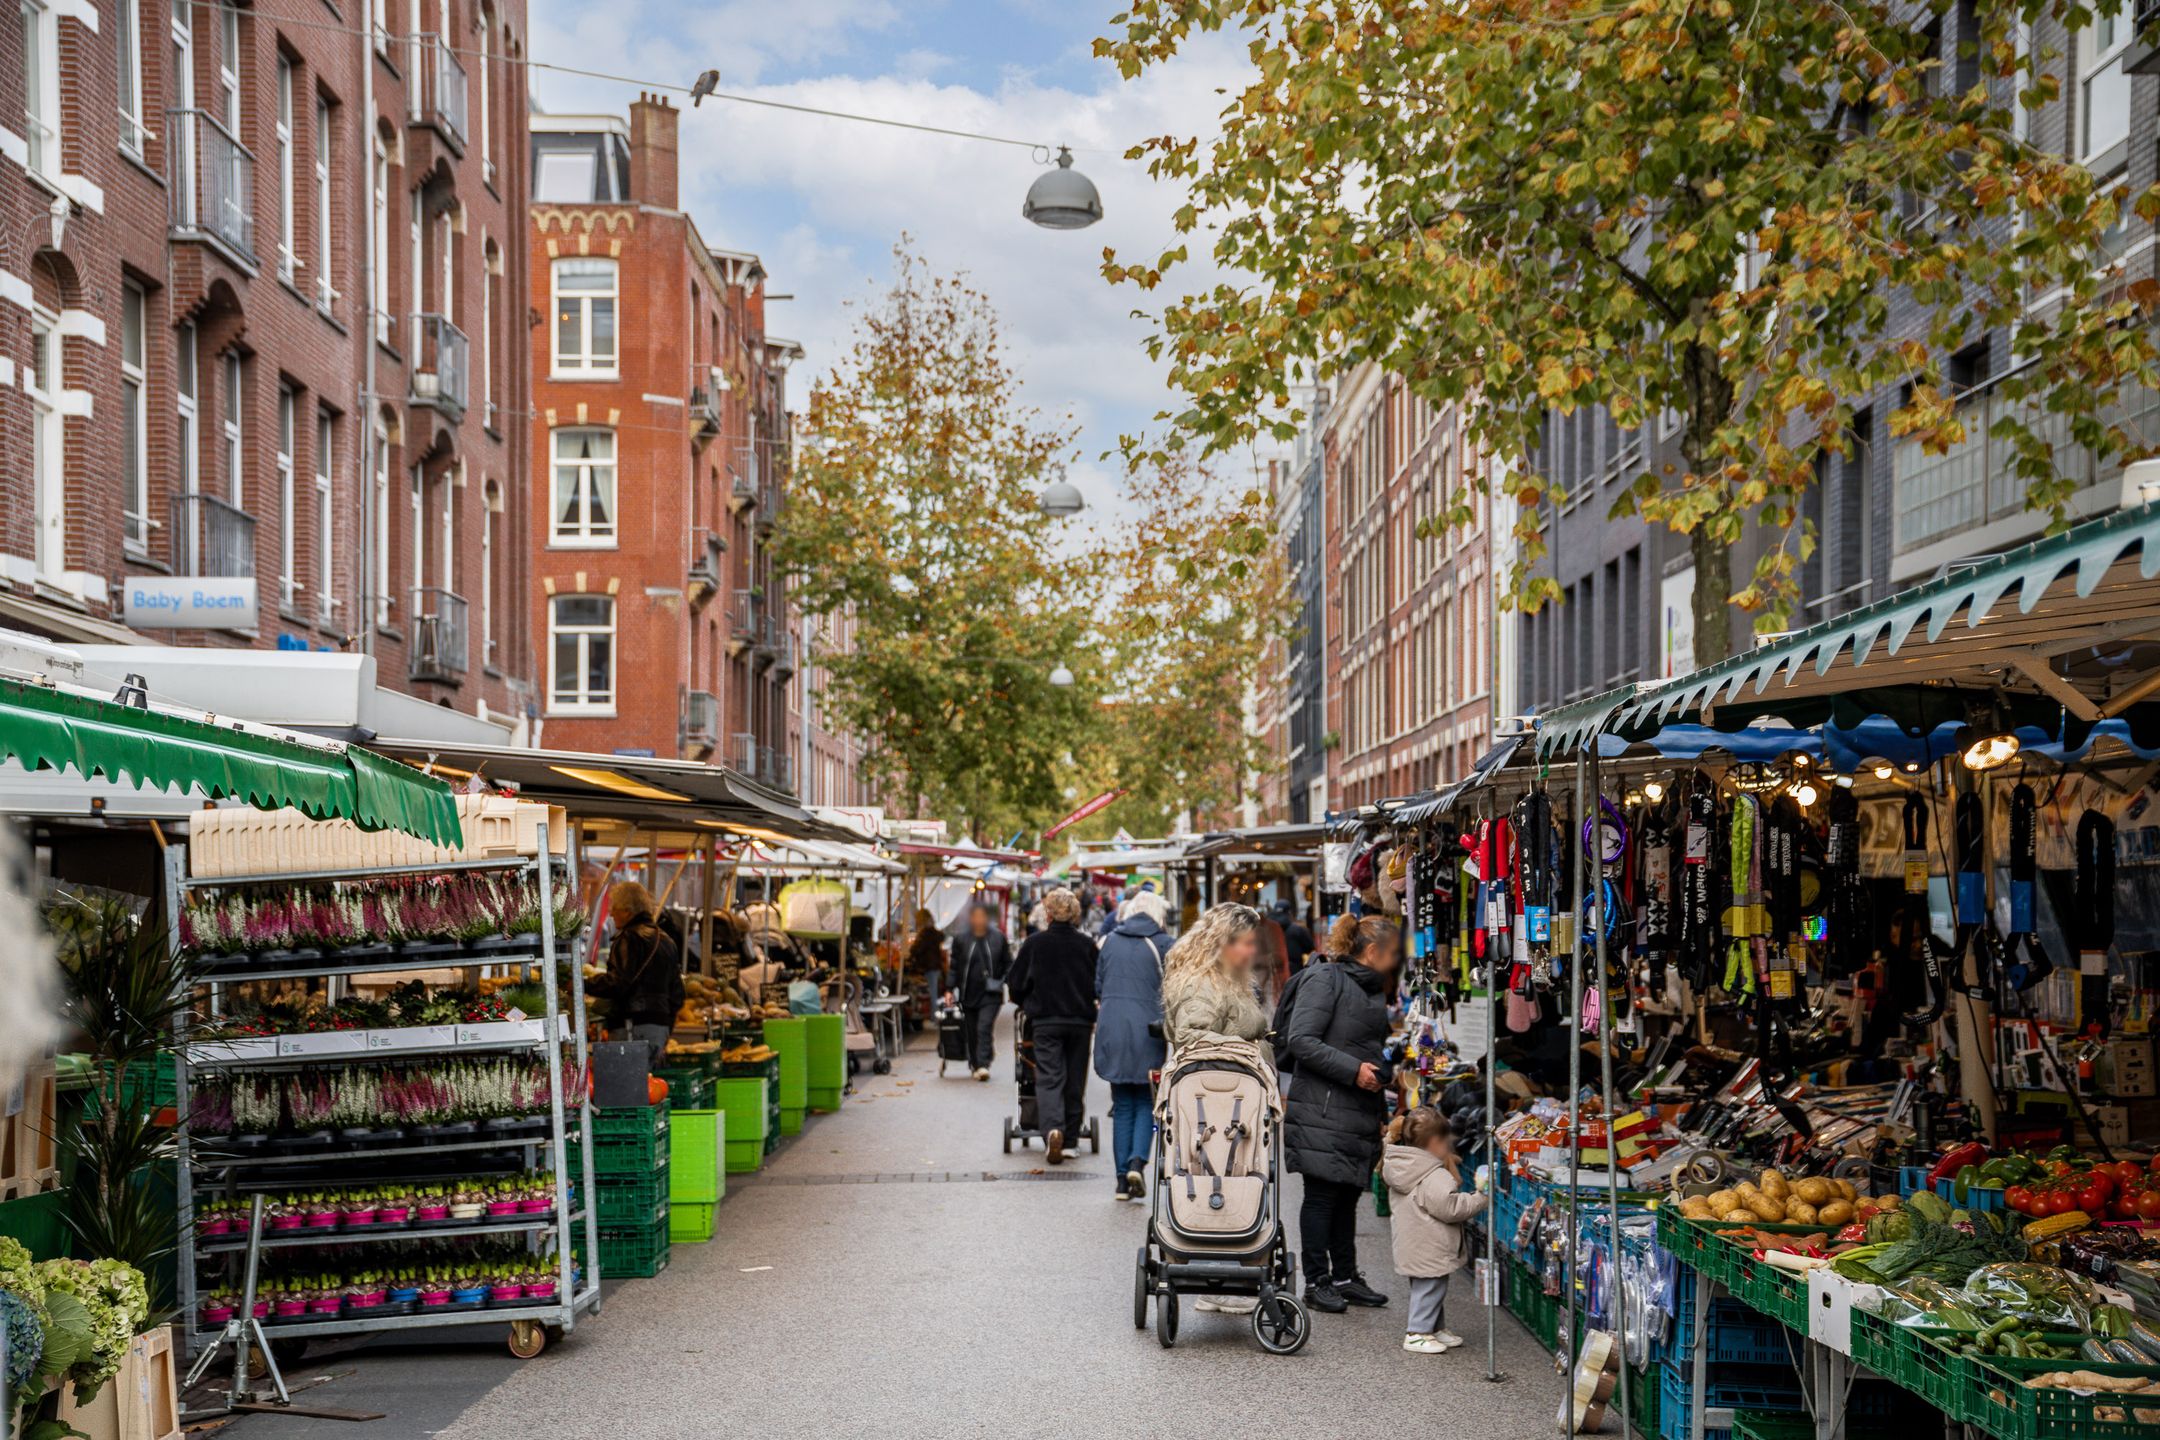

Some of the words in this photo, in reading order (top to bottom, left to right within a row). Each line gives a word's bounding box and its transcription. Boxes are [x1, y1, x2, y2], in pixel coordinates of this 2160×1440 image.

[133, 590, 183, 614] Baby
[192, 590, 245, 608] Boem
[1781, 832, 1792, 876] STAHLEX
[1696, 864, 1707, 903] Walfo
[1647, 898, 1659, 936] AXA
